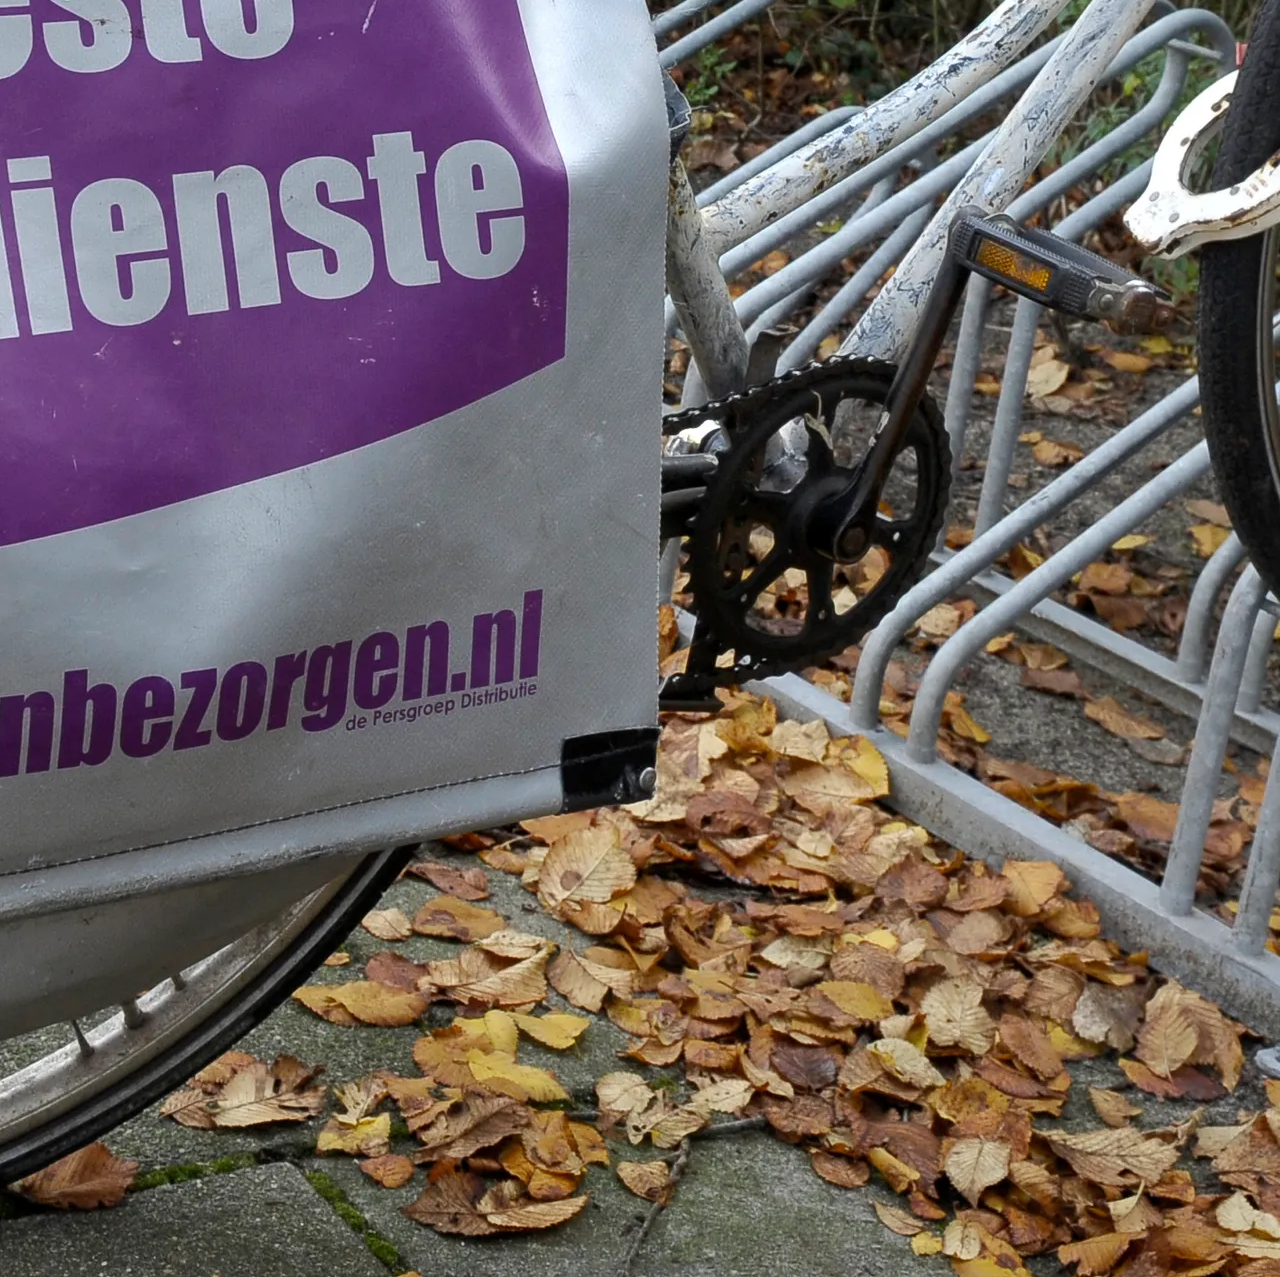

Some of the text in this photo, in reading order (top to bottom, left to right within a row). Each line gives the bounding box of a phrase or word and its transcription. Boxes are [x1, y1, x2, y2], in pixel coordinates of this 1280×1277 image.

[345, 682, 537, 732] de Persgroep Distributie
